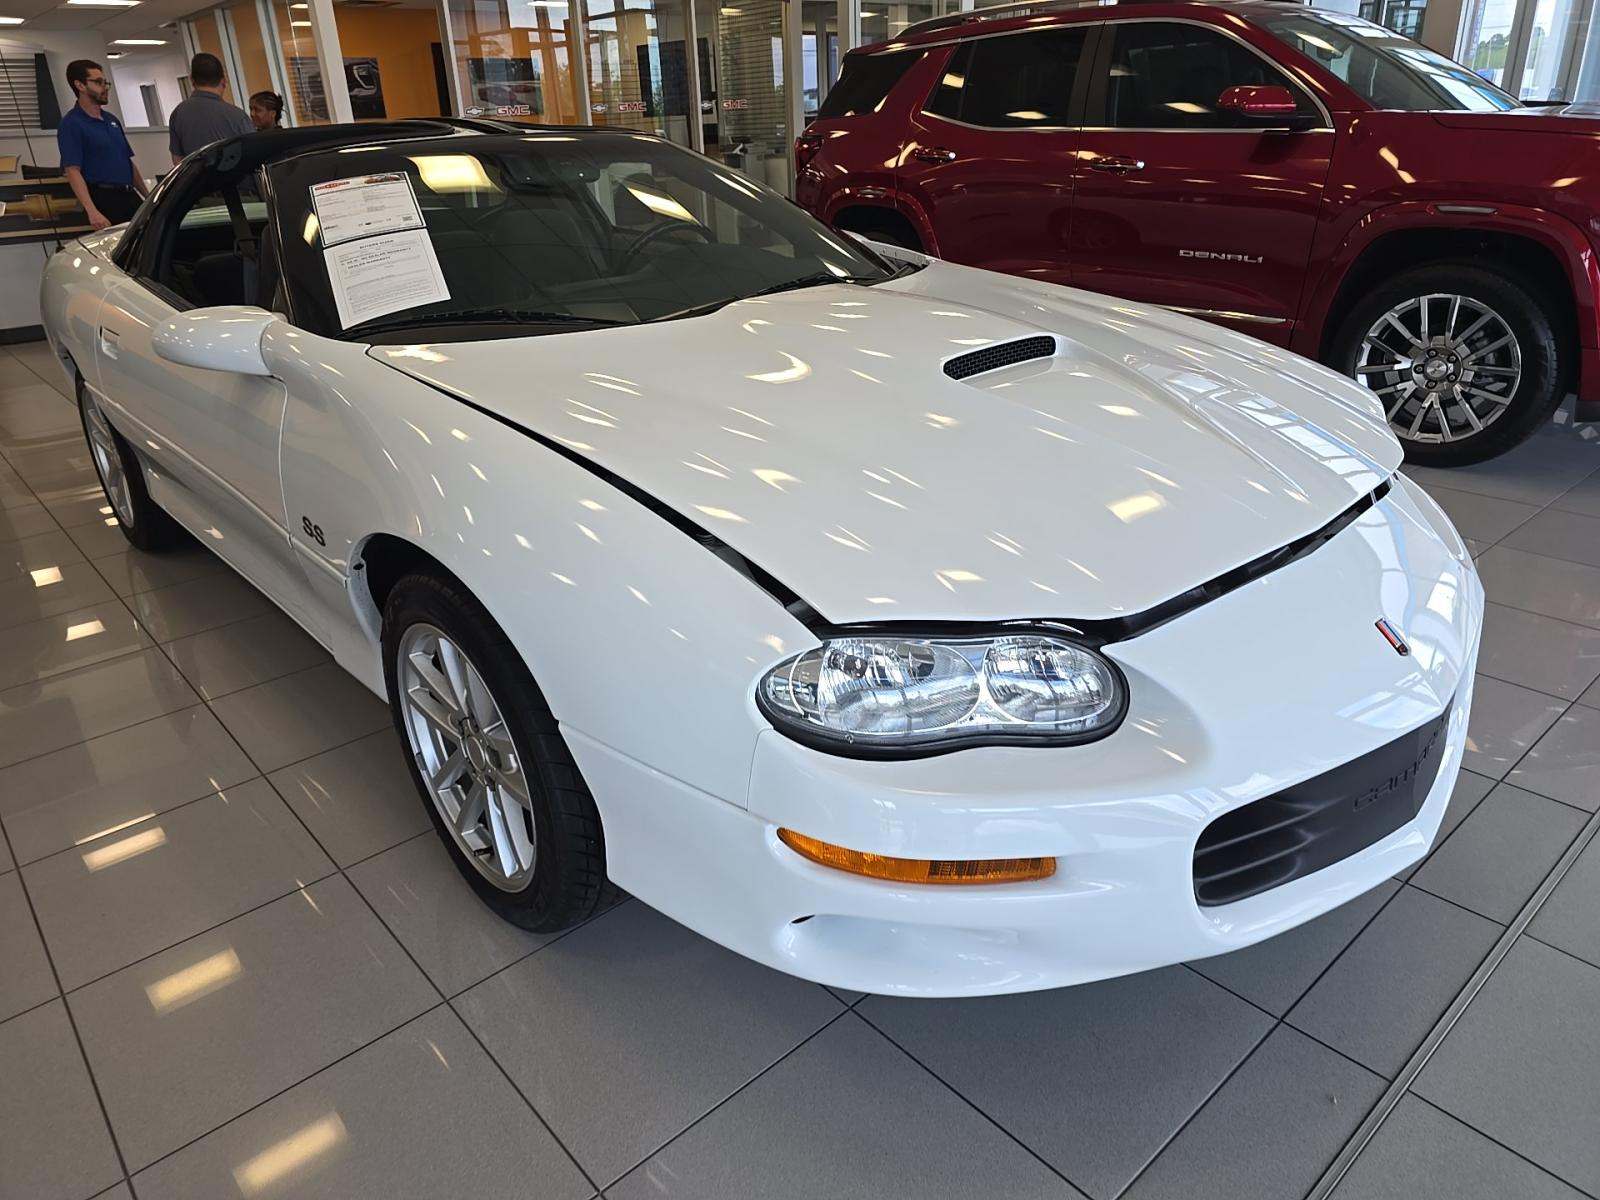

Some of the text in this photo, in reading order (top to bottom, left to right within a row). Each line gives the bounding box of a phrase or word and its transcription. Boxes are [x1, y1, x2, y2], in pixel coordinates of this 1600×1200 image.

[496, 104, 530, 117] GMC
[617, 101, 647, 113] GMC
[722, 99, 749, 110] GMC
[1179, 249, 1263, 264] DENALI
[302, 516, 326, 547] SS
